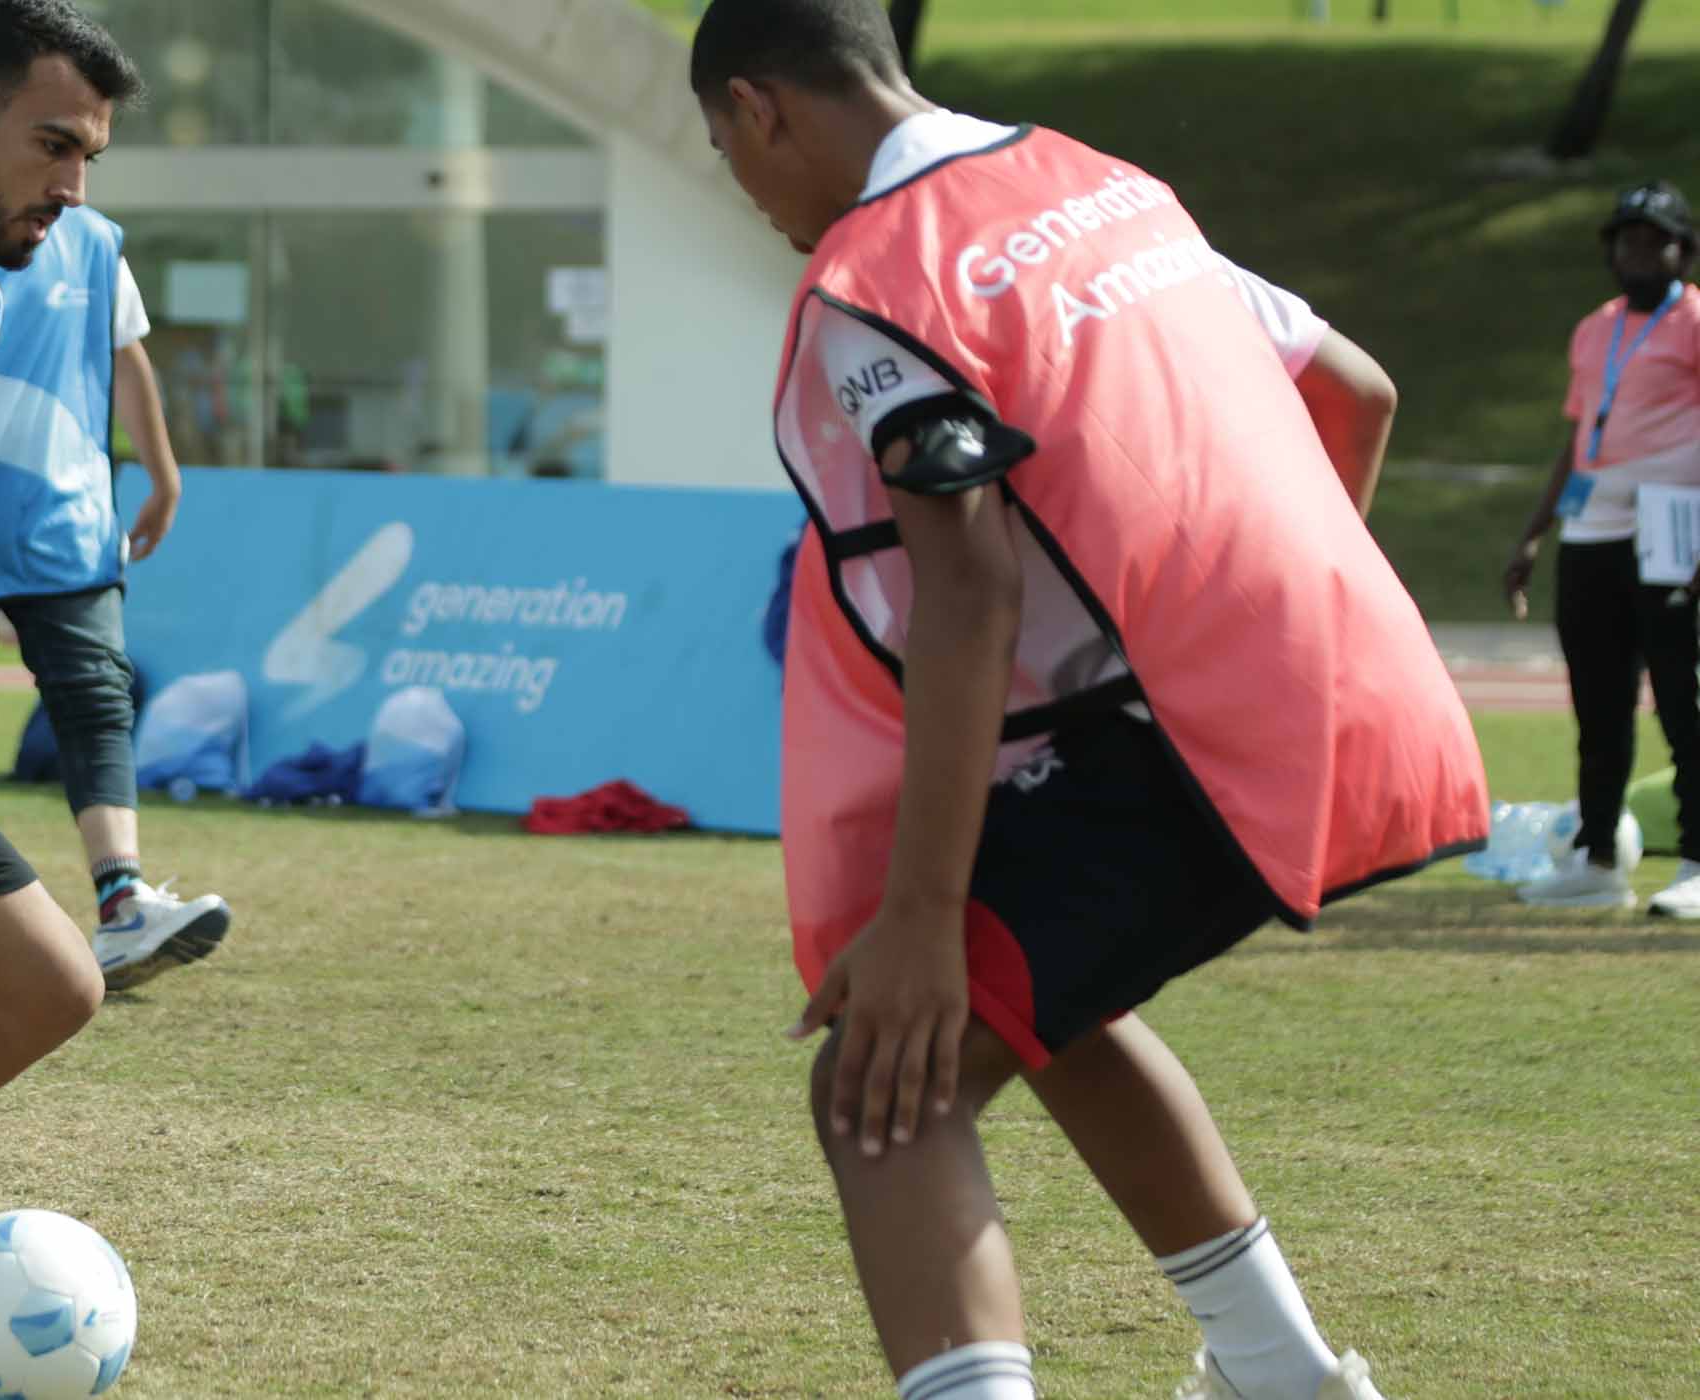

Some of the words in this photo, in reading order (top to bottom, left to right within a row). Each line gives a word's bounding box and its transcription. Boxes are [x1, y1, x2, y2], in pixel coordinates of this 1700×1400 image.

[956, 167, 1174, 298] Generatio
[1050, 231, 1234, 347] Amazin
[837, 357, 903, 416] QNB
[403, 576, 628, 637] generation
[382, 642, 559, 714] amazing
